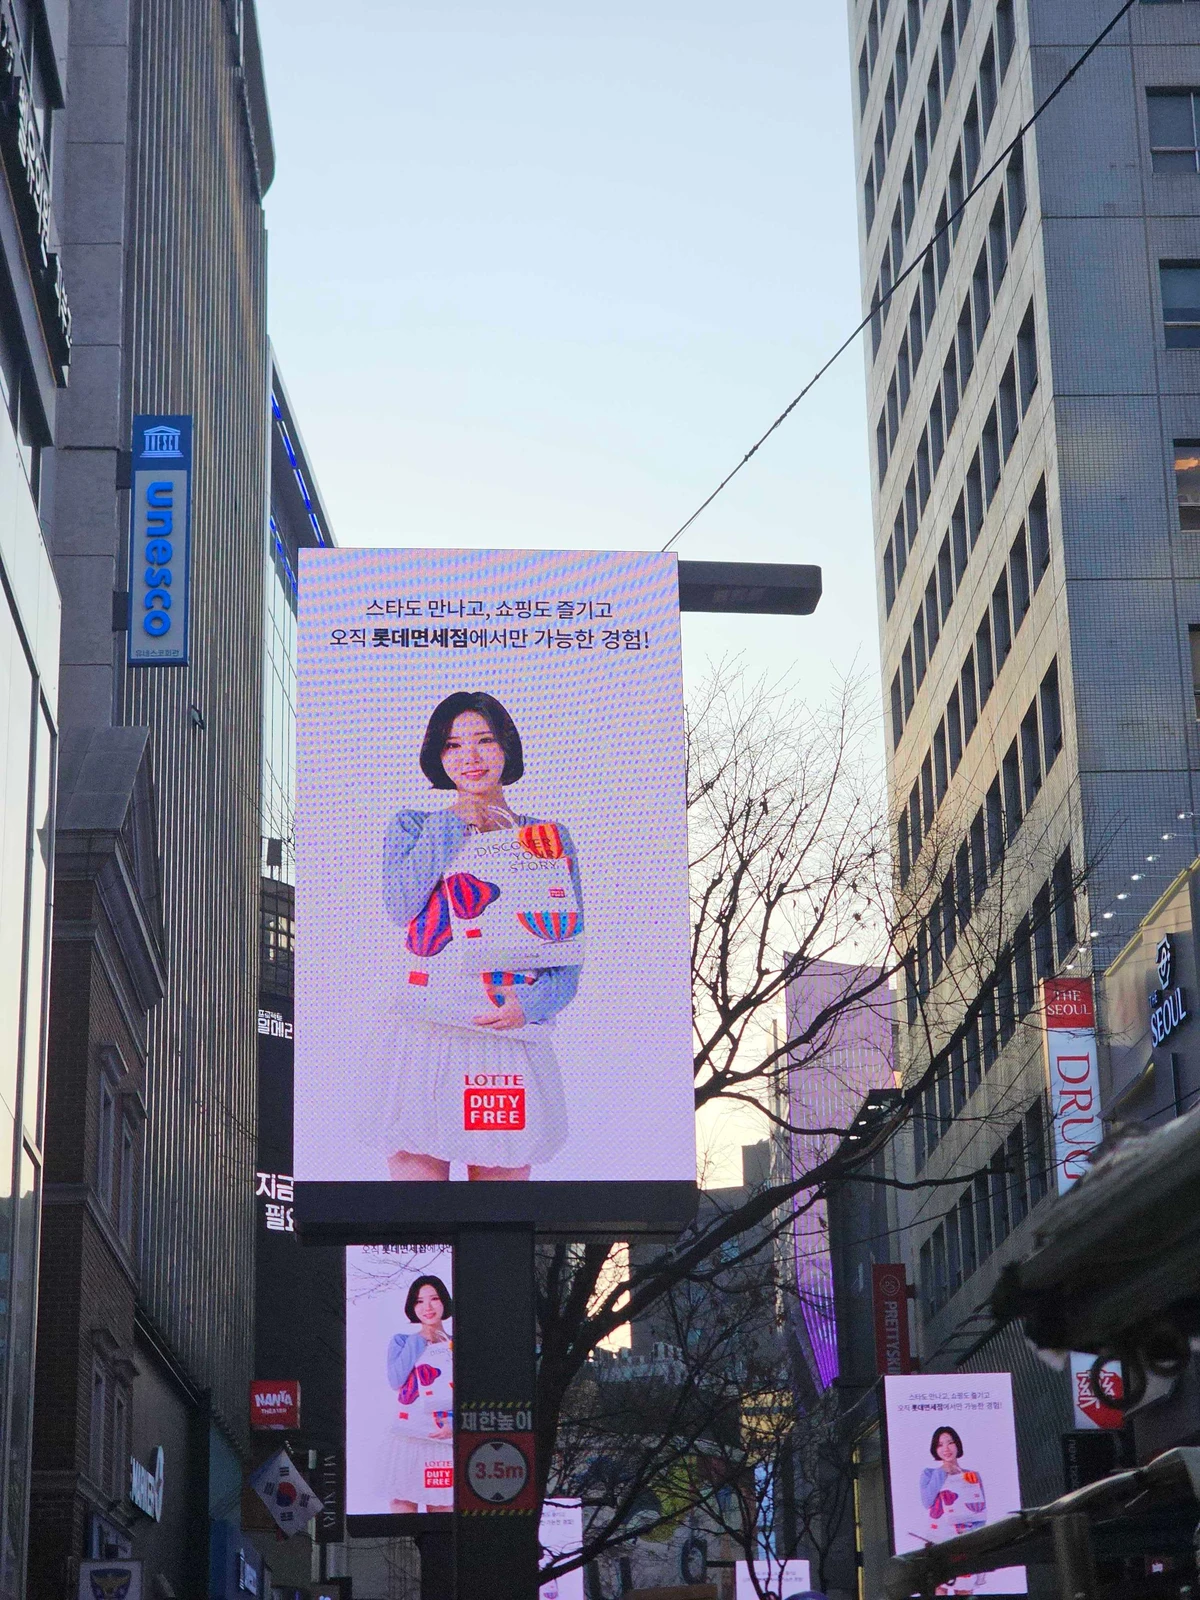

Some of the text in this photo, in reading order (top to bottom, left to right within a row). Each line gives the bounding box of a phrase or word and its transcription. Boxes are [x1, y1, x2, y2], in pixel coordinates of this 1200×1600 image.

[143, 481, 174, 637] unesco
[366, 599, 613, 620] 스타도 만나고, 쇼핑도 즐기고
[329, 628, 649, 651] 오직 롯데면세점에서만 가능한 경험!
[476, 838, 552, 857] DISCOVER
[512, 850, 555, 861] YOUR
[510, 861, 557, 873] STORY
[1053, 990, 1081, 1002] THE
[1047, 1004, 1092, 1016] SEOUL
[1150, 987, 1187, 1048] SEOUL
[464, 1074, 524, 1086] LOTTE
[470, 1095, 519, 1109] DUTY
[470, 1110, 519, 1124] FREE
[254, 1389, 293, 1407] NANTA
[461, 1410, 532, 1431] 제한높이
[427, 1470, 450, 1478] DUTY
[475, 1461, 523, 1479] 3.5m
[427, 1478, 450, 1486] FREE
